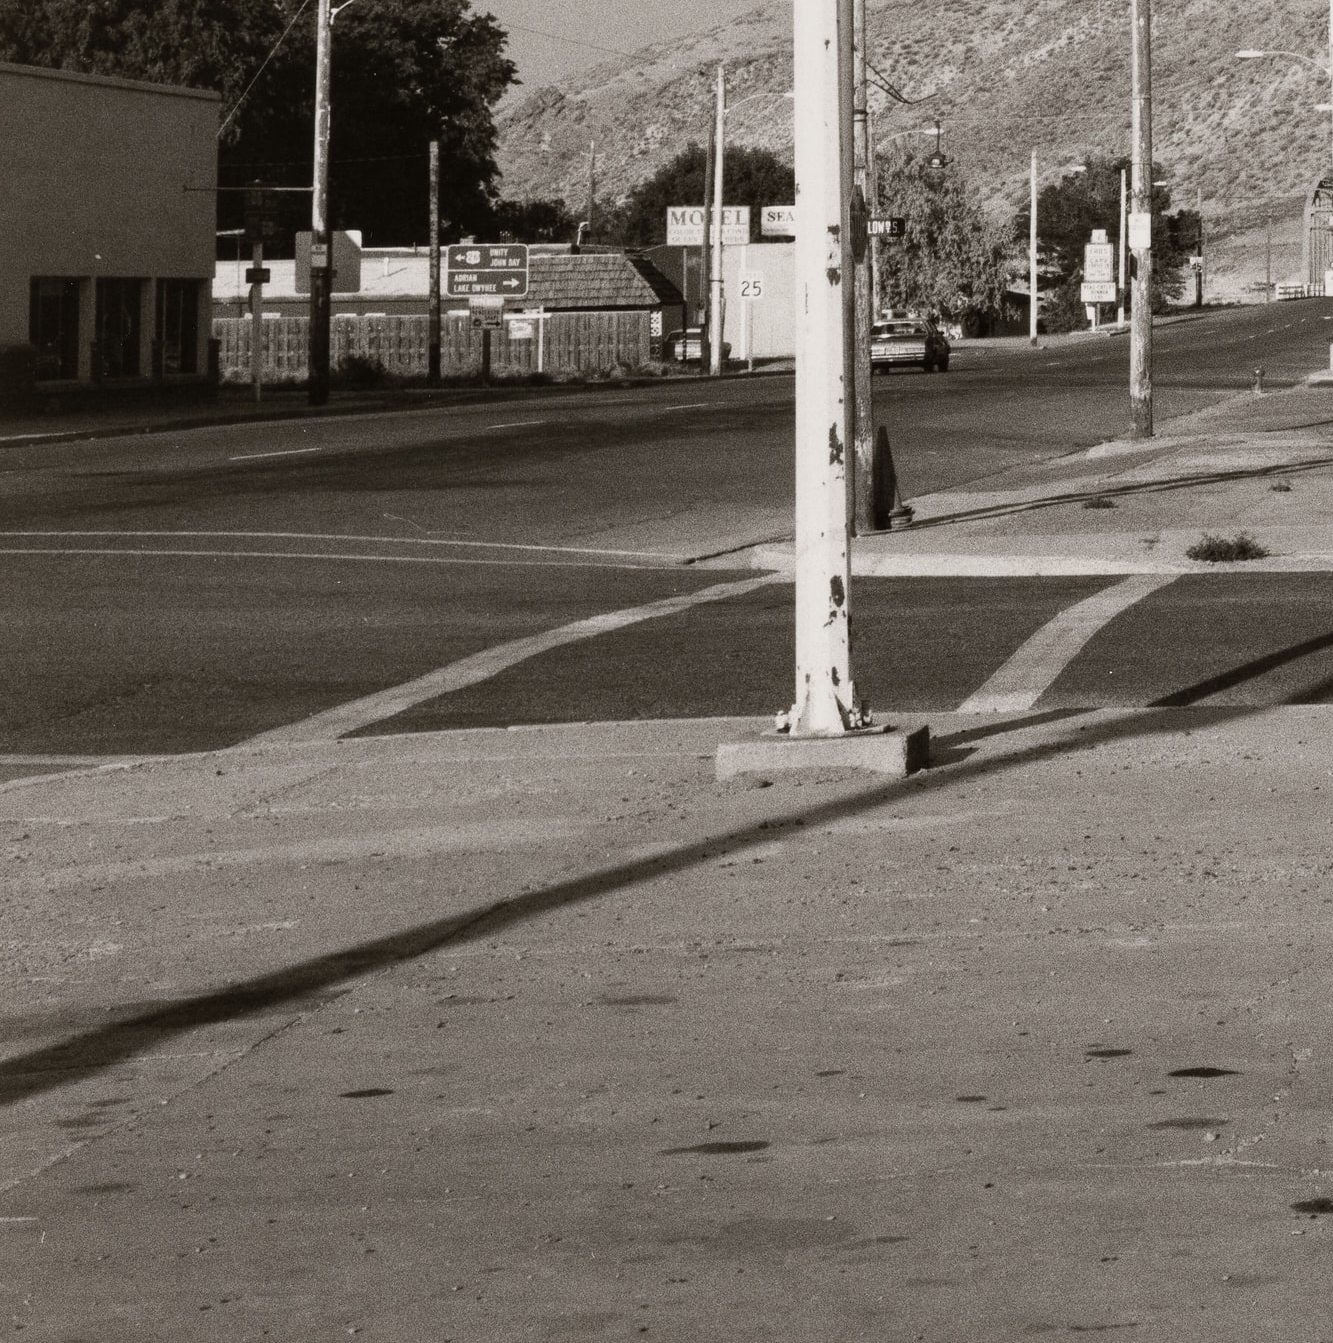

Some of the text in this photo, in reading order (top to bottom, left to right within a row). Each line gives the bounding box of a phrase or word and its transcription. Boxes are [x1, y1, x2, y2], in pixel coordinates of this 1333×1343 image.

[670, 209, 748, 226] MOEL
[508, 258, 521, 267] DAY
[453, 284, 469, 293] LAKE
[741, 280, 762, 297] 25
